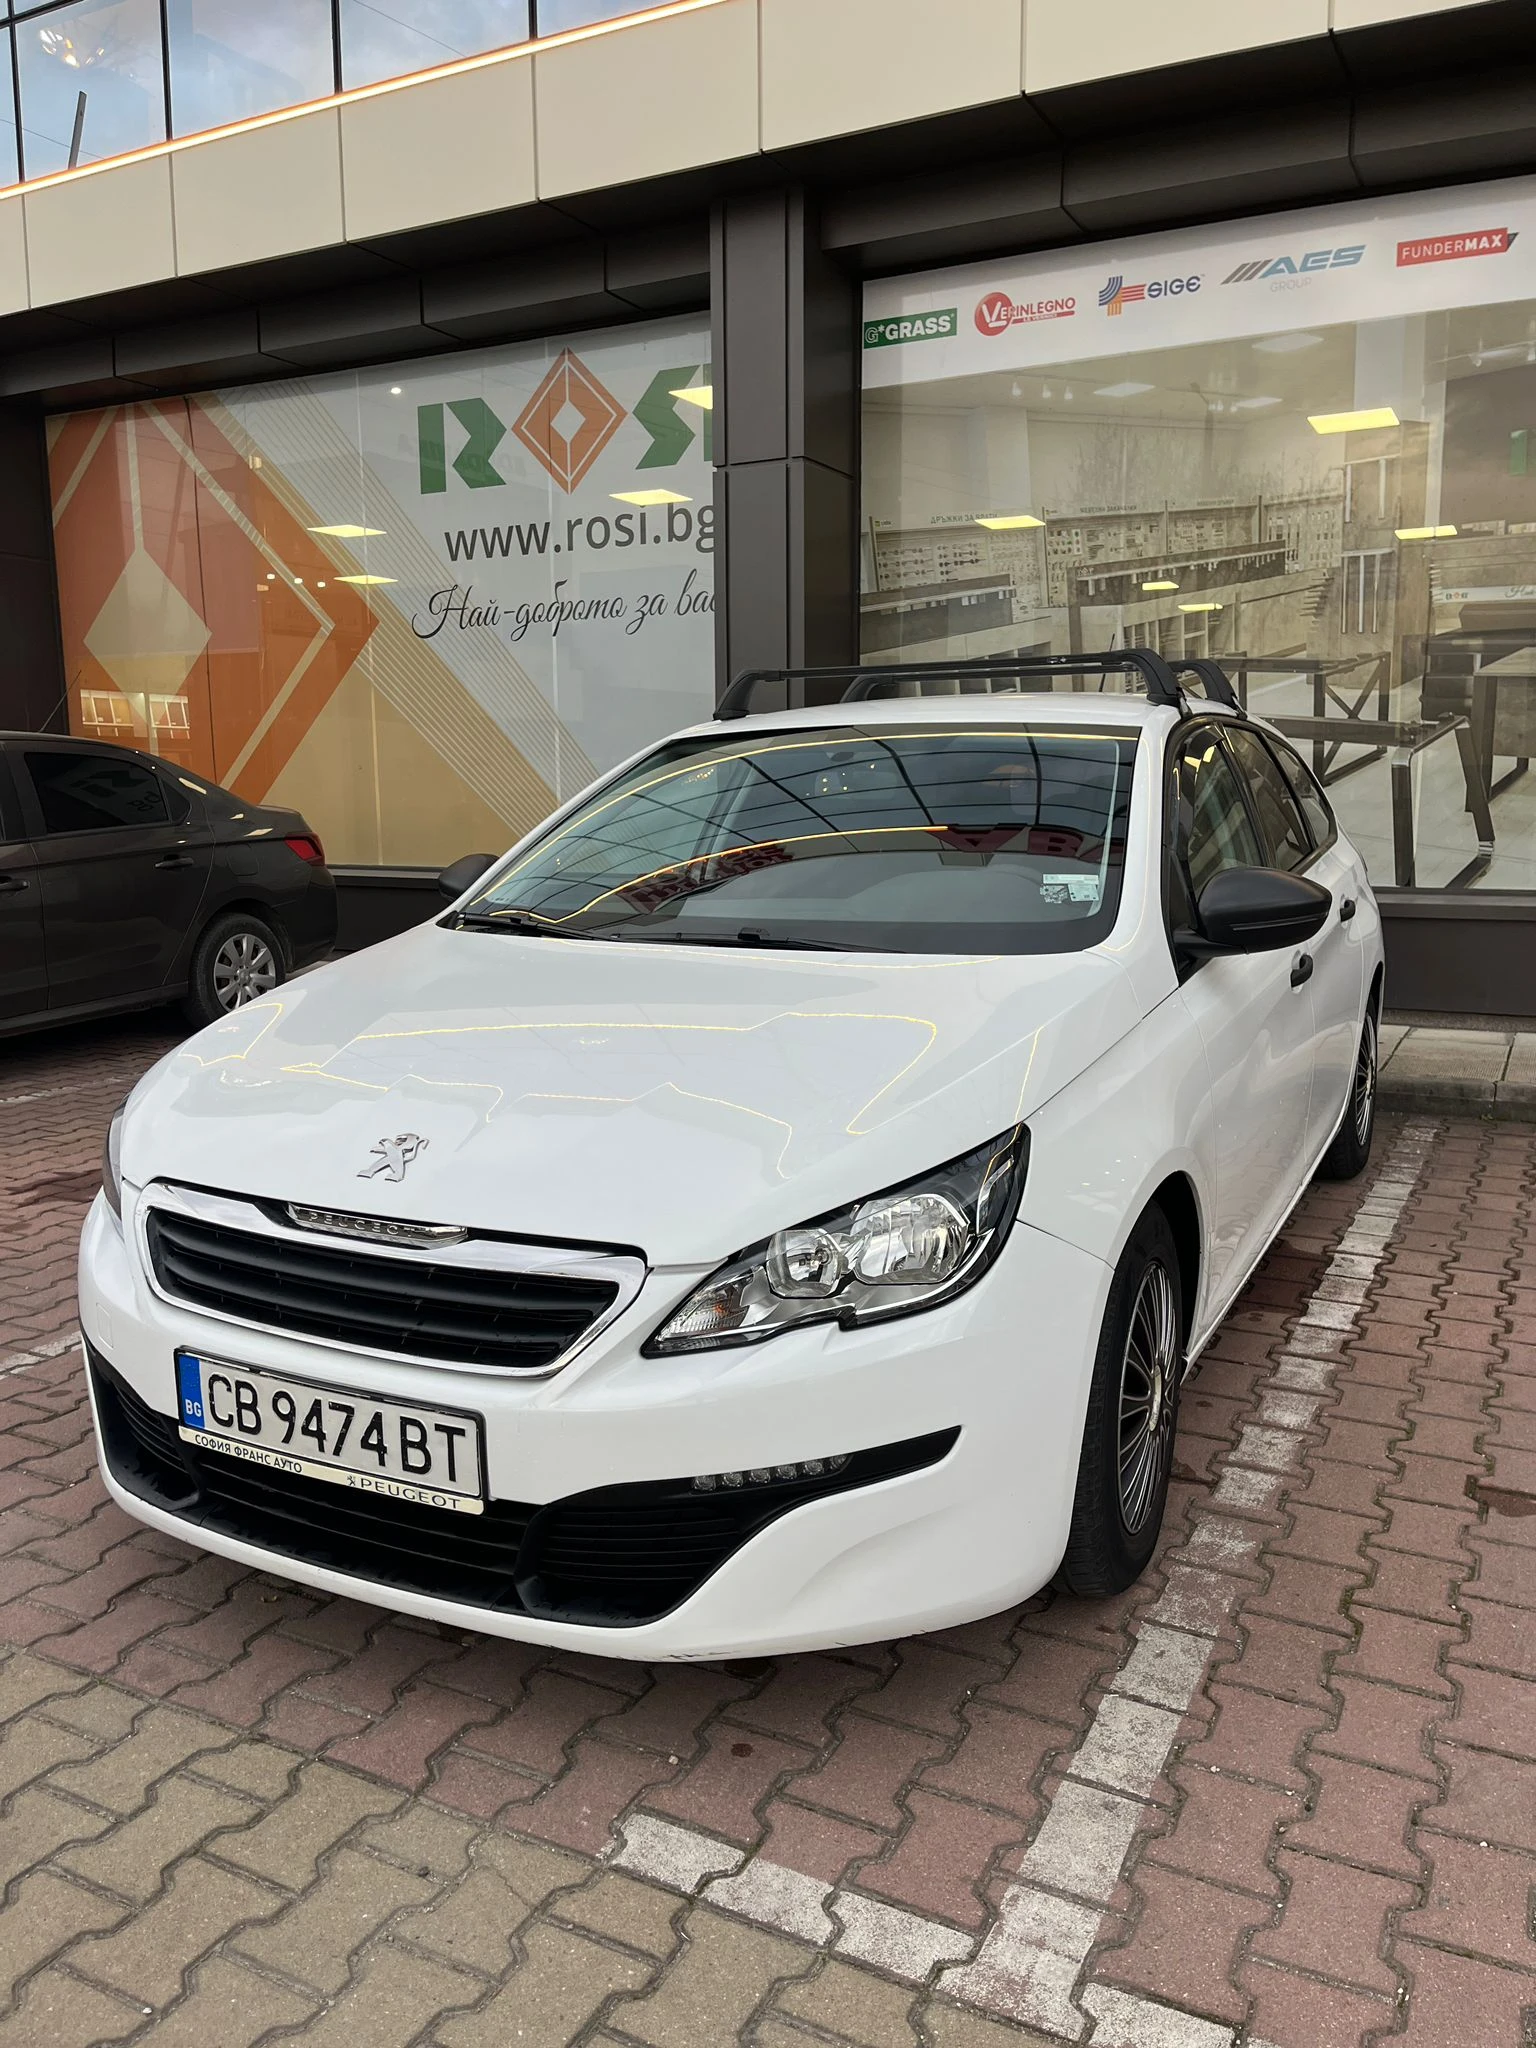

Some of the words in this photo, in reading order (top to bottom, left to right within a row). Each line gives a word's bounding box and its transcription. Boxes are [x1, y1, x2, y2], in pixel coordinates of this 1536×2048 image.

[1258, 244, 1367, 279] AES
[1402, 233, 1503, 260] FUNDERMAX
[1147, 275, 1201, 299] SIGE
[1269, 276, 1313, 293] GROUP
[981, 297, 1076, 328] VERINLEGNO
[444, 502, 715, 562] www.rosi.bg
[412, 579, 627, 641] Най-доброто
[625, 591, 668, 635] за
[184, 1398, 202, 1419] BG
[194, 1434, 232, 1454] СОФИЯ
[234, 1445, 272, 1465] ФРАНС
[273, 1456, 303, 1474] АУТО
[360, 1477, 461, 1510] PEUGEOT
